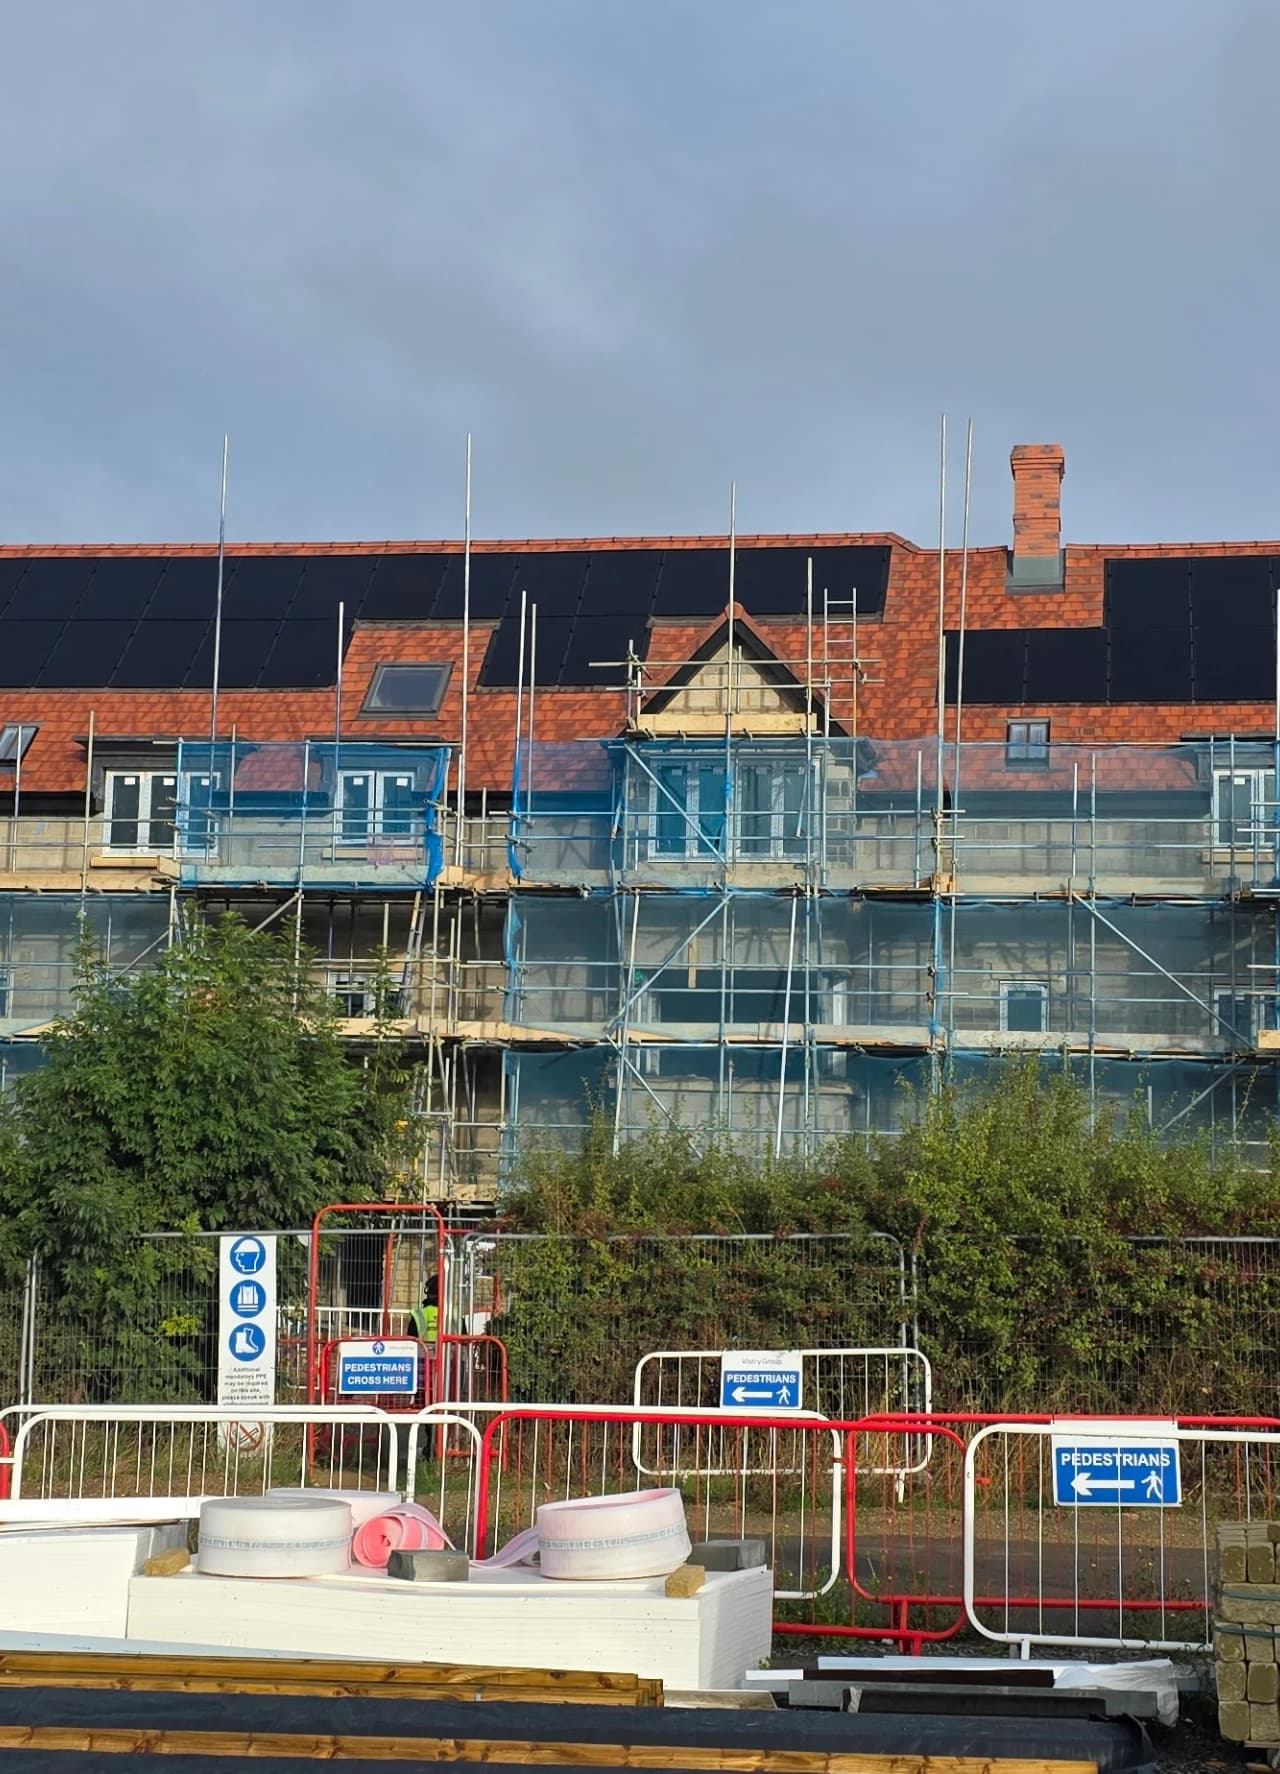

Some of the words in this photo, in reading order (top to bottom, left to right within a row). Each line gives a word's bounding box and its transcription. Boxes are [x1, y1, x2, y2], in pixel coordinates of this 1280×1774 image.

[344, 1363, 411, 1372] PEDESTRIANS
[347, 1376, 381, 1385] CROSS
[382, 1376, 409, 1385] HERE
[727, 1374, 796, 1384] PEDESTRIANS
[1061, 1453, 1170, 1466] PEDESTRIANS
